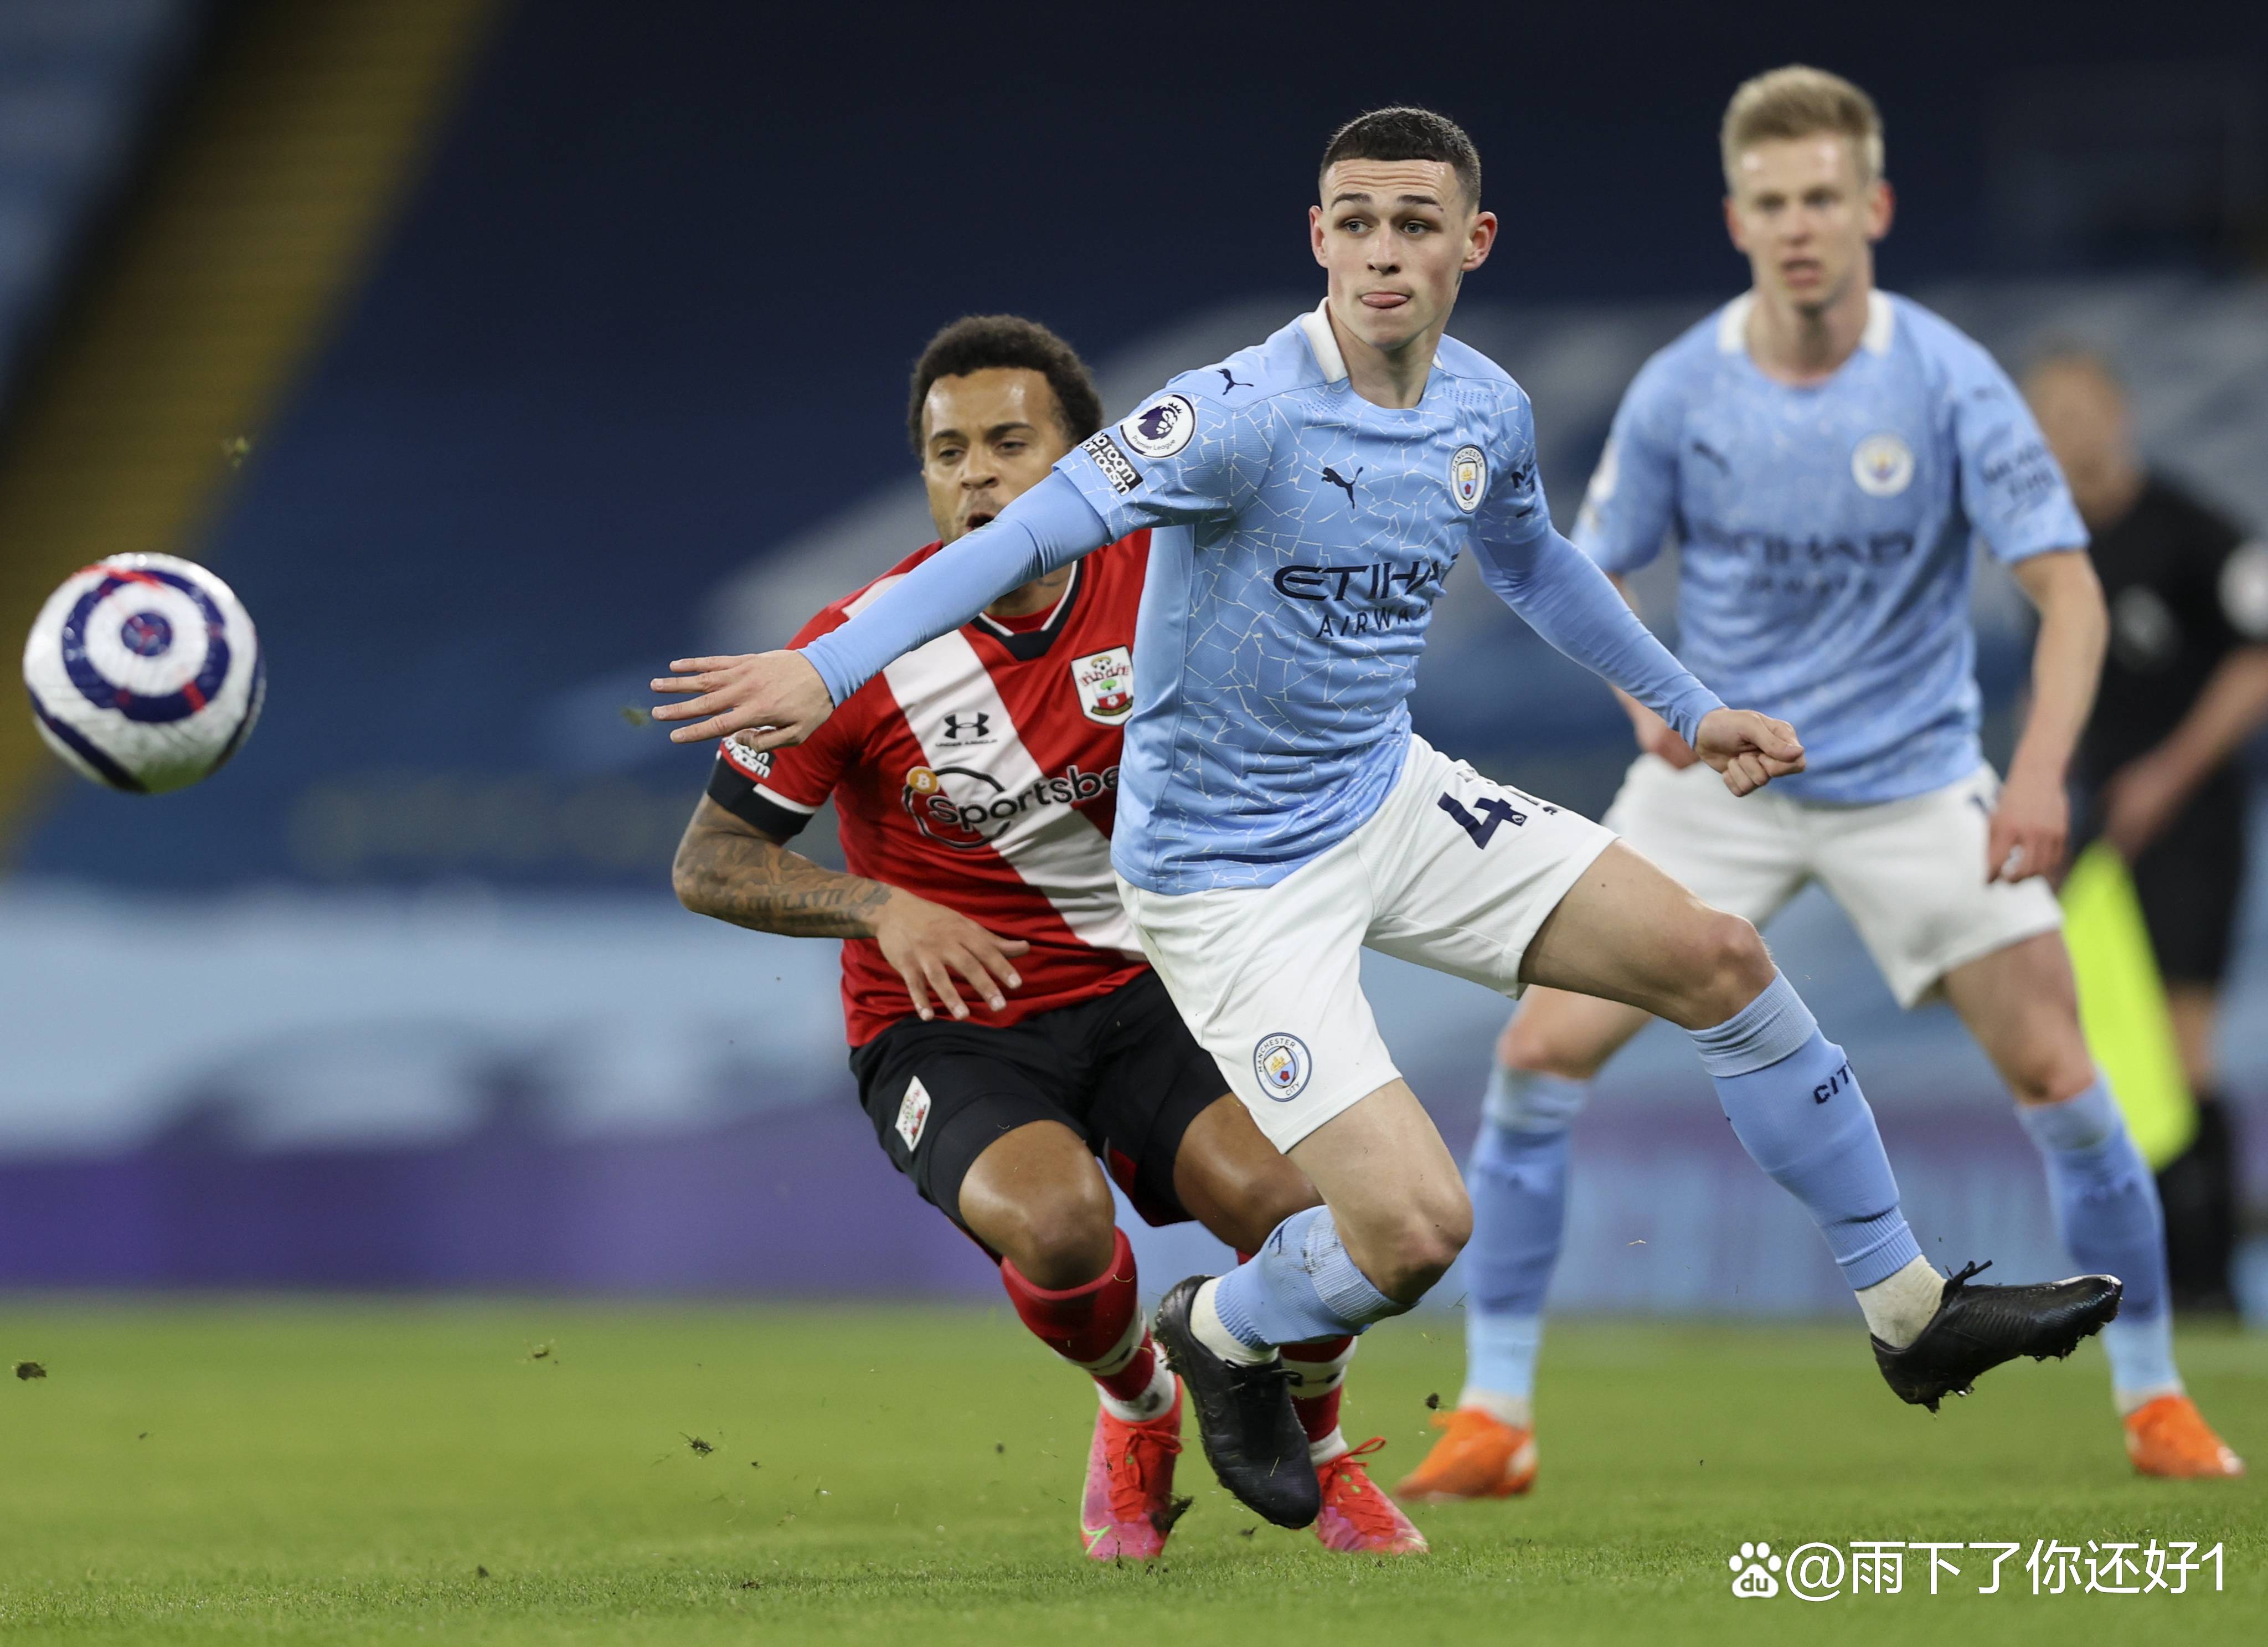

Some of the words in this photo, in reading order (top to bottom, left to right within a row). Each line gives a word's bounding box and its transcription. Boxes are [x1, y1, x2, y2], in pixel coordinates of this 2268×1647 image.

[1132, 435, 1152, 450] Premier
[1153, 439, 1176, 451] League
[1452, 450, 1483, 472] MANCHESTER
[1092, 450, 1130, 496] racism
[1102, 445, 1136, 483] room
[1274, 554, 1460, 601] ETIHA
[927, 765, 1119, 831] Sportsbe
[1258, 1038, 1296, 1072] MANCHESTER
[1285, 1082, 1300, 1096] CITY
